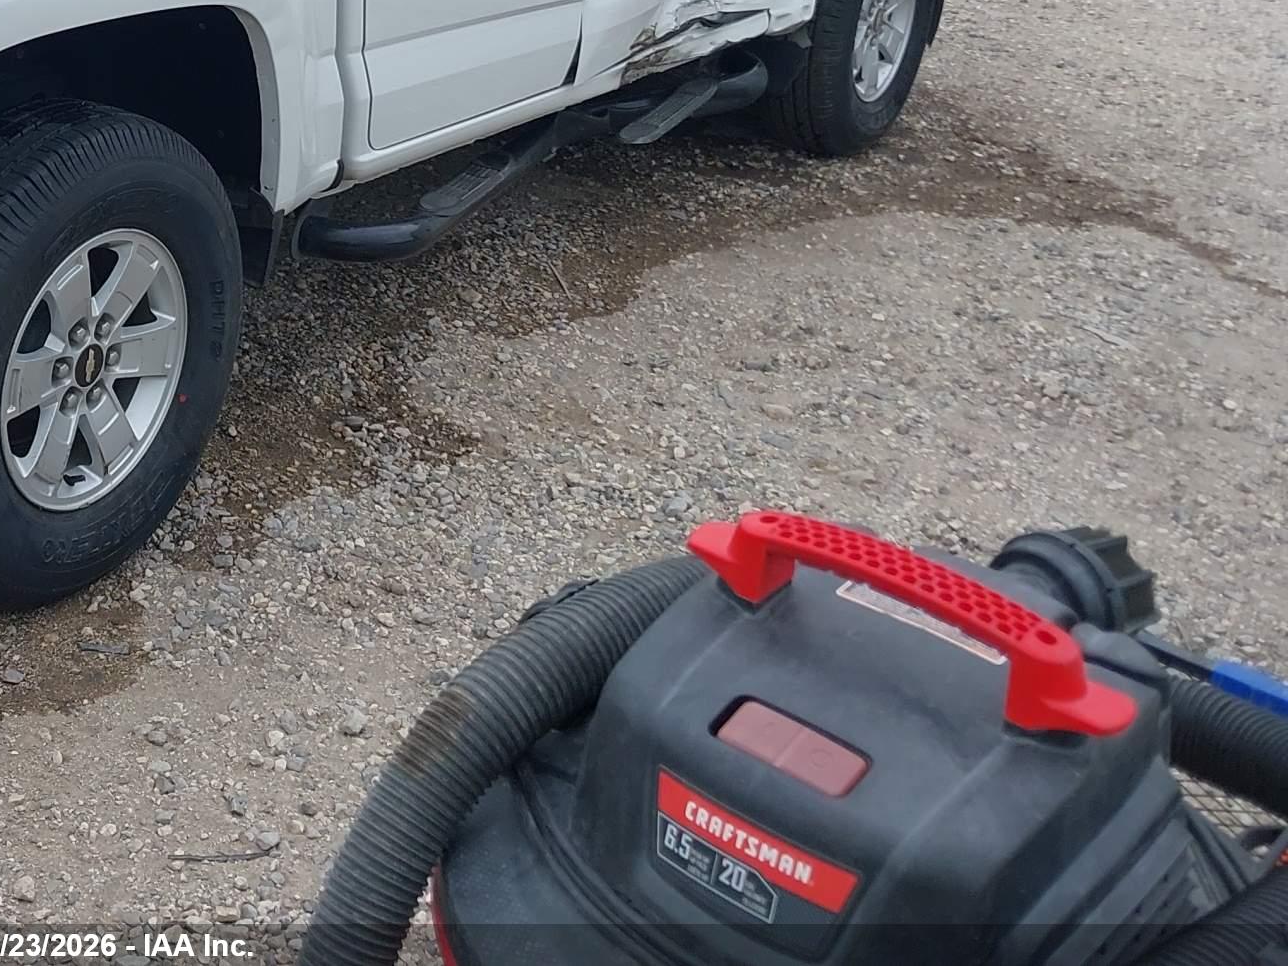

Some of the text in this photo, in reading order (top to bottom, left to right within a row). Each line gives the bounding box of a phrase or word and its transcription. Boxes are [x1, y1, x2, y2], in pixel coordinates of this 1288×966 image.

[663, 823, 692, 861] 6.5
[684, 800, 813, 884] CRAFTSMAN
[718, 859, 747, 893] 20
